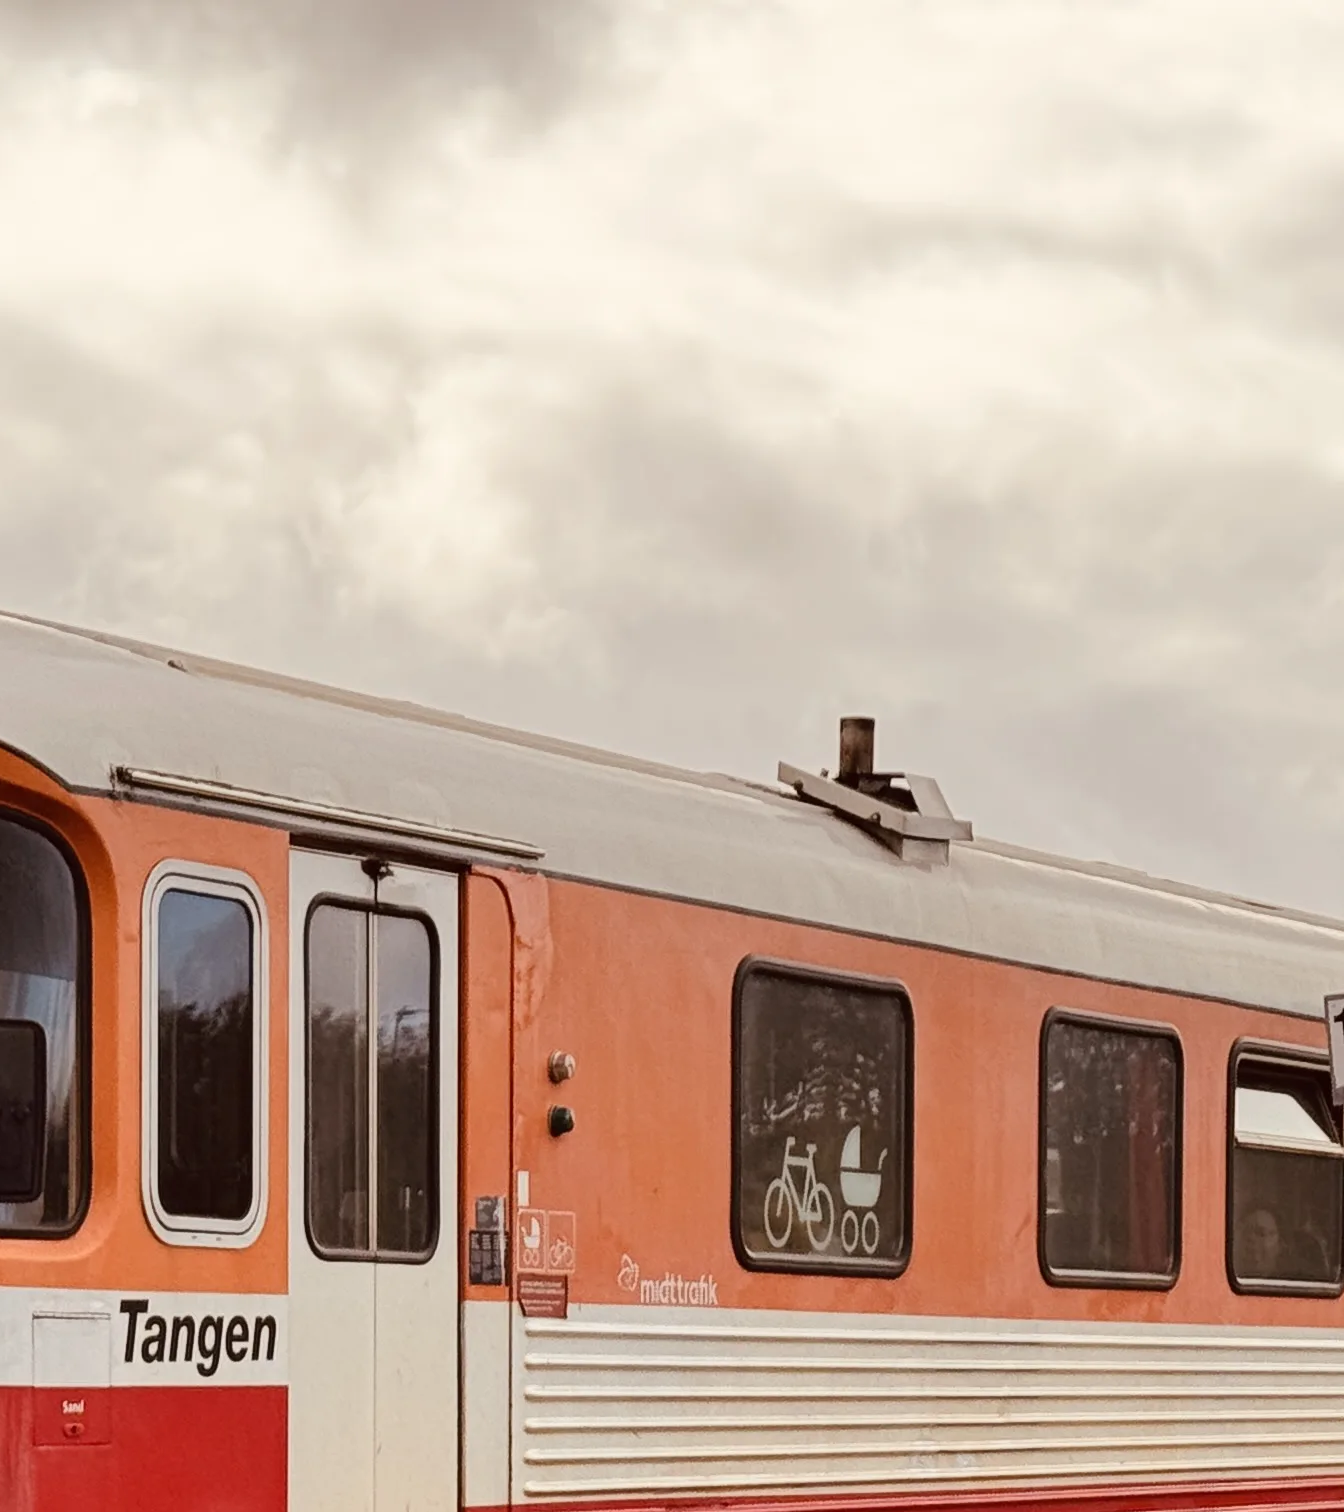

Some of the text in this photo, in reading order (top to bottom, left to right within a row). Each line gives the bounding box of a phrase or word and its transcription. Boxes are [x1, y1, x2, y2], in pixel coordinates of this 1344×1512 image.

[639, 1271, 719, 1306] midttrafik
[119, 1298, 278, 1378] Tangen
[62, 1399, 85, 1415] Sand
